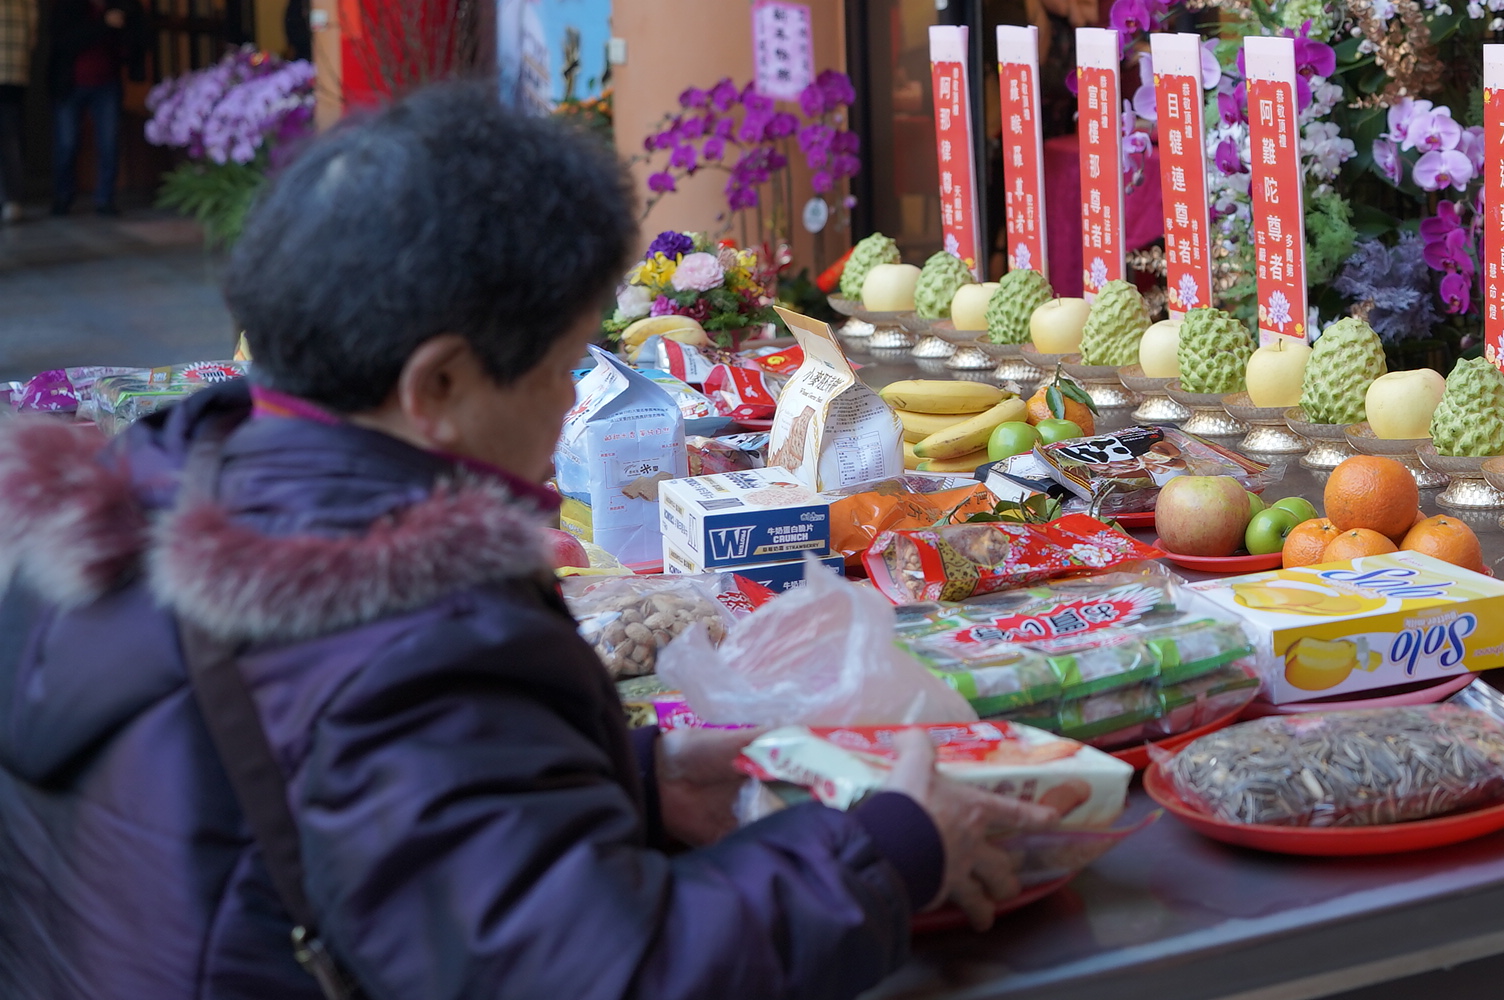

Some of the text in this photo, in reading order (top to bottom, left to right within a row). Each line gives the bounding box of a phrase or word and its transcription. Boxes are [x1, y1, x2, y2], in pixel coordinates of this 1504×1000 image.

[1275, 89, 1288, 149] 恭敬頂禮
[1259, 99, 1284, 282] 阿難陀尊者
[772, 532, 809, 544] CRUNCH
[785, 542, 820, 551] STRAWBERRY
[1391, 613, 1477, 675] Solo
